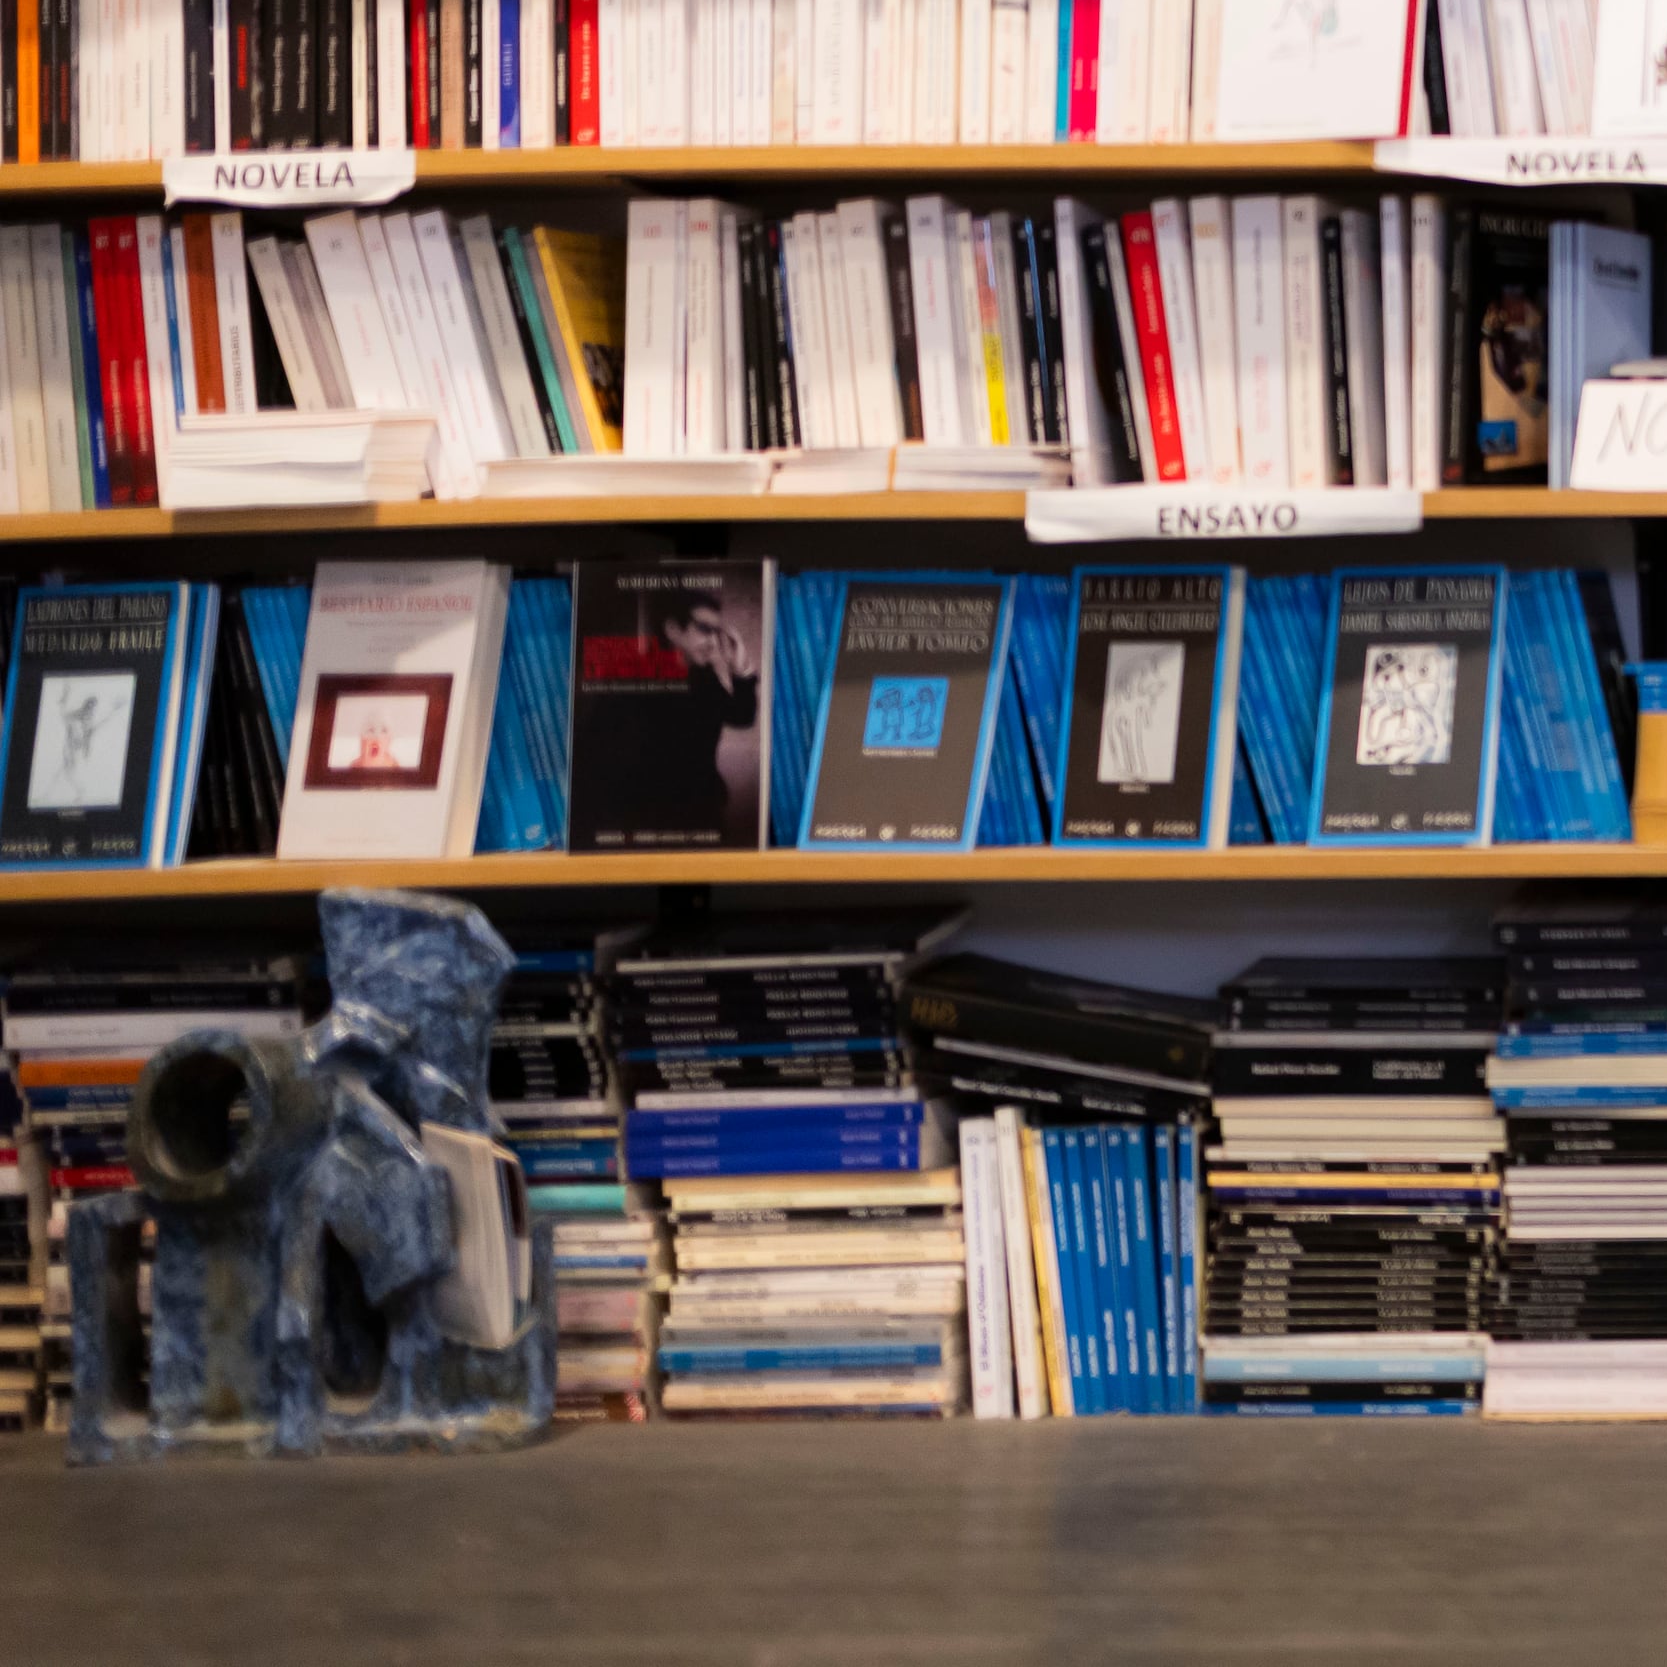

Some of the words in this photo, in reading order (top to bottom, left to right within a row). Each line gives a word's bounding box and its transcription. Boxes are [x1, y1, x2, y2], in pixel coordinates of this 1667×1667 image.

[214, 160, 355, 191] NOVELA
[1506, 151, 1646, 176] NOVELA
[1159, 504, 1298, 535] ENSAYO
[319, 594, 401, 614] BESTIARIO
[406, 593, 472, 613] ESPAÑOL
[1392, 580, 1415, 603] DE
[92, 598, 115, 620] DEL
